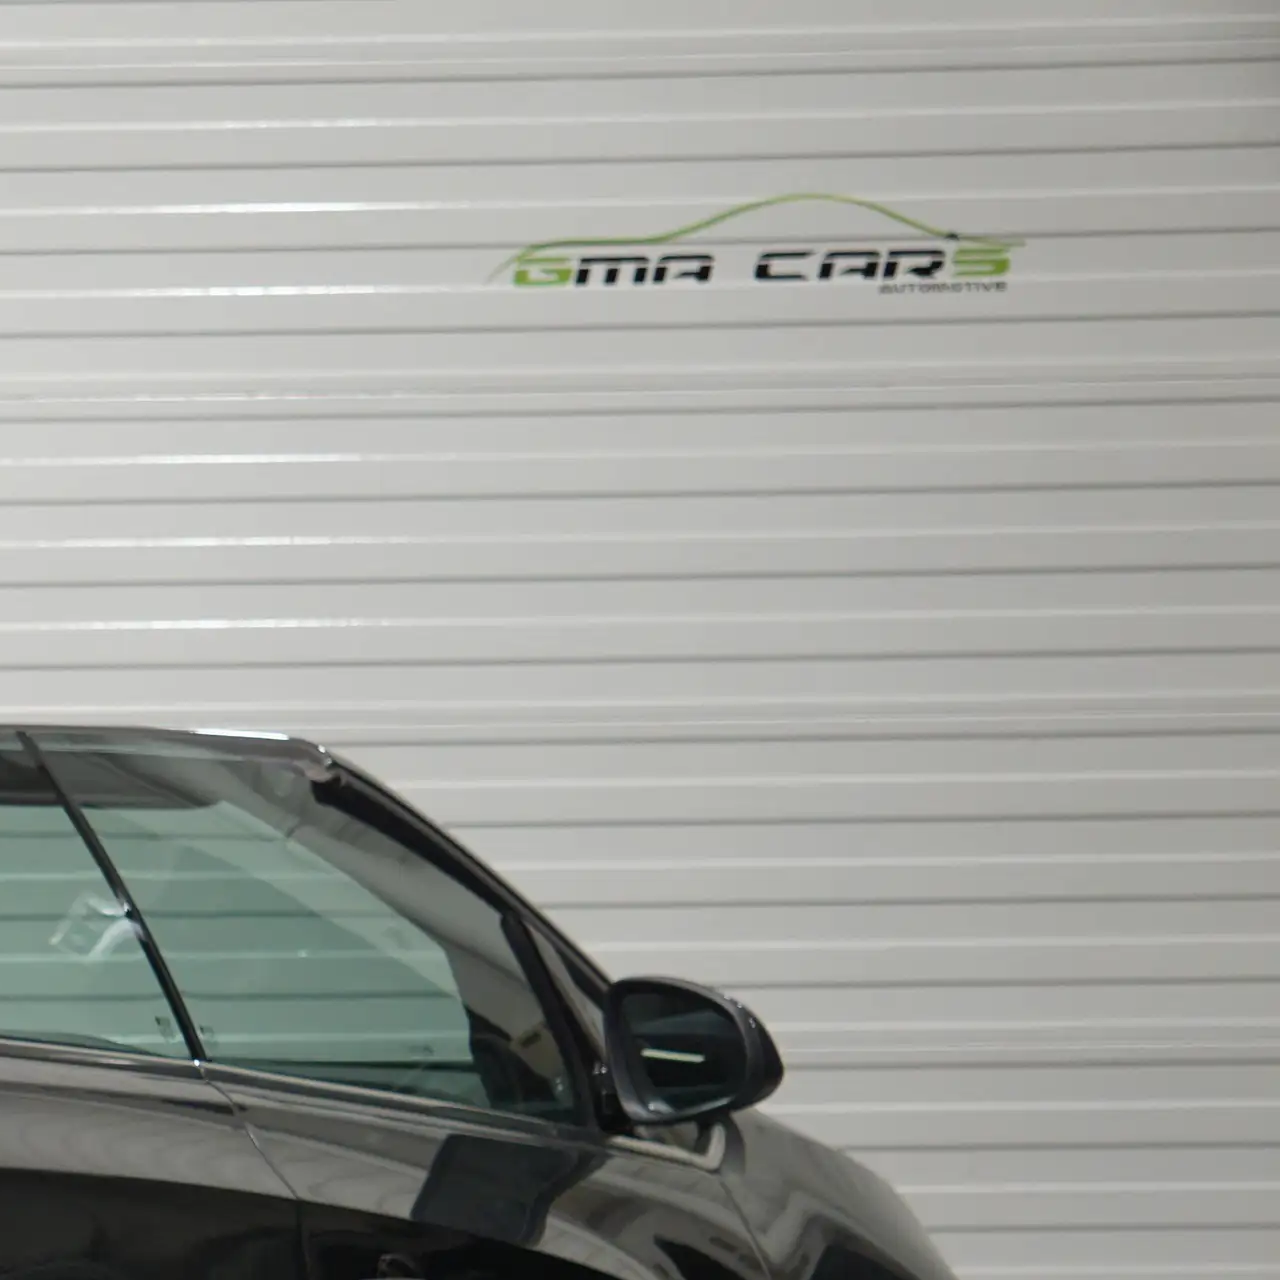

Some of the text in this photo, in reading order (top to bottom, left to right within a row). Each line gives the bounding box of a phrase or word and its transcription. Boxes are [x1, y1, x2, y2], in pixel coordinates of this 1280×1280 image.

[513, 247, 1011, 287] GMA CARS
[878, 281, 1008, 294] AUTOMOTIVE
